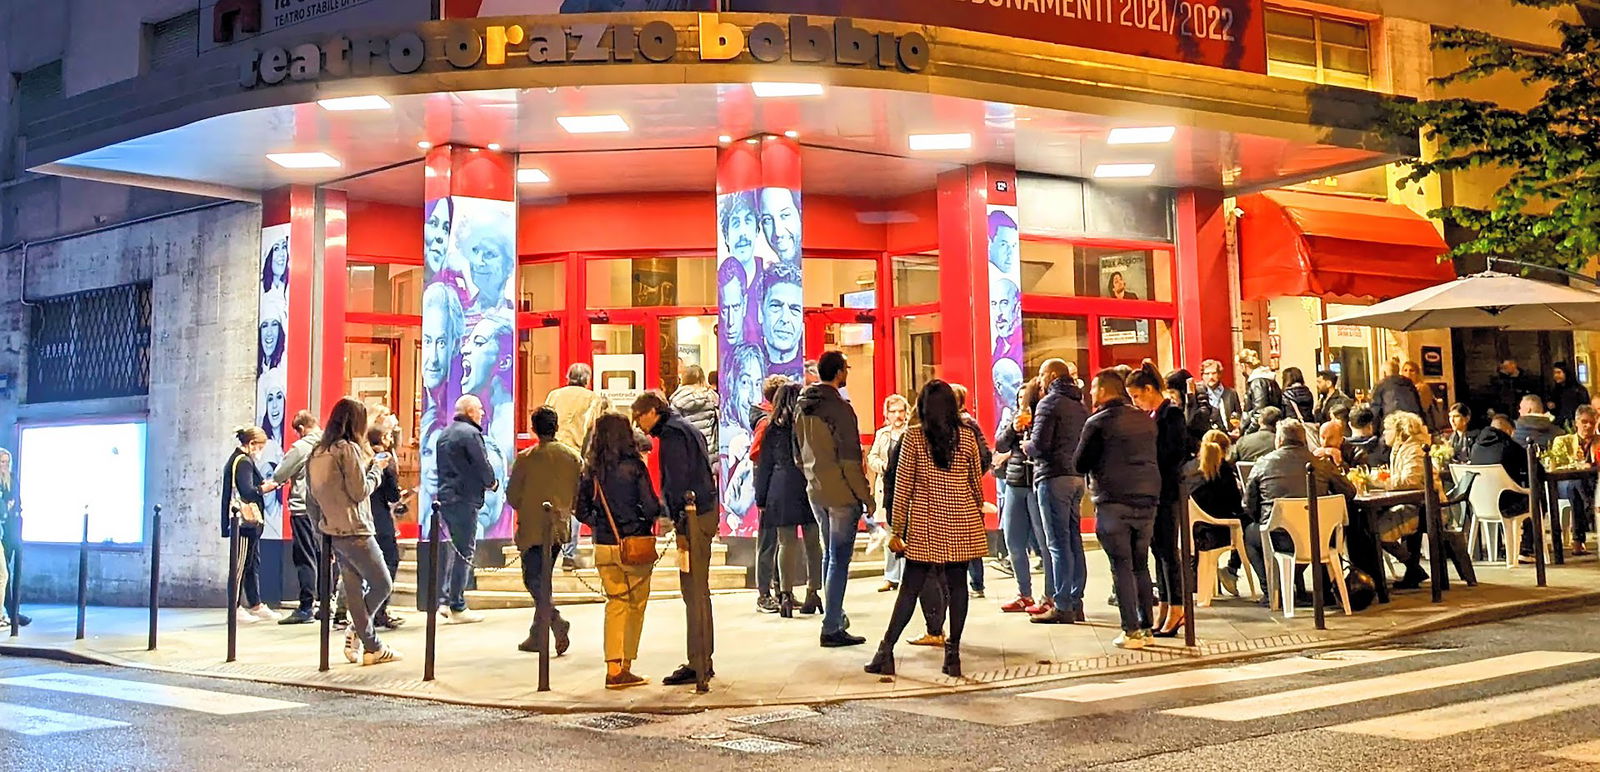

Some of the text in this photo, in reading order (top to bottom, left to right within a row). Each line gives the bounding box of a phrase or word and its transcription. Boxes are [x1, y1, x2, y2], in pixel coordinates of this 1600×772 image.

[274, 9, 305, 27] TEATRO
[306, 0, 339, 17] STABILE
[1119, 0, 1235, 42] 2021/2022
[240, 12, 930, 88] teatro orazio bobbio
